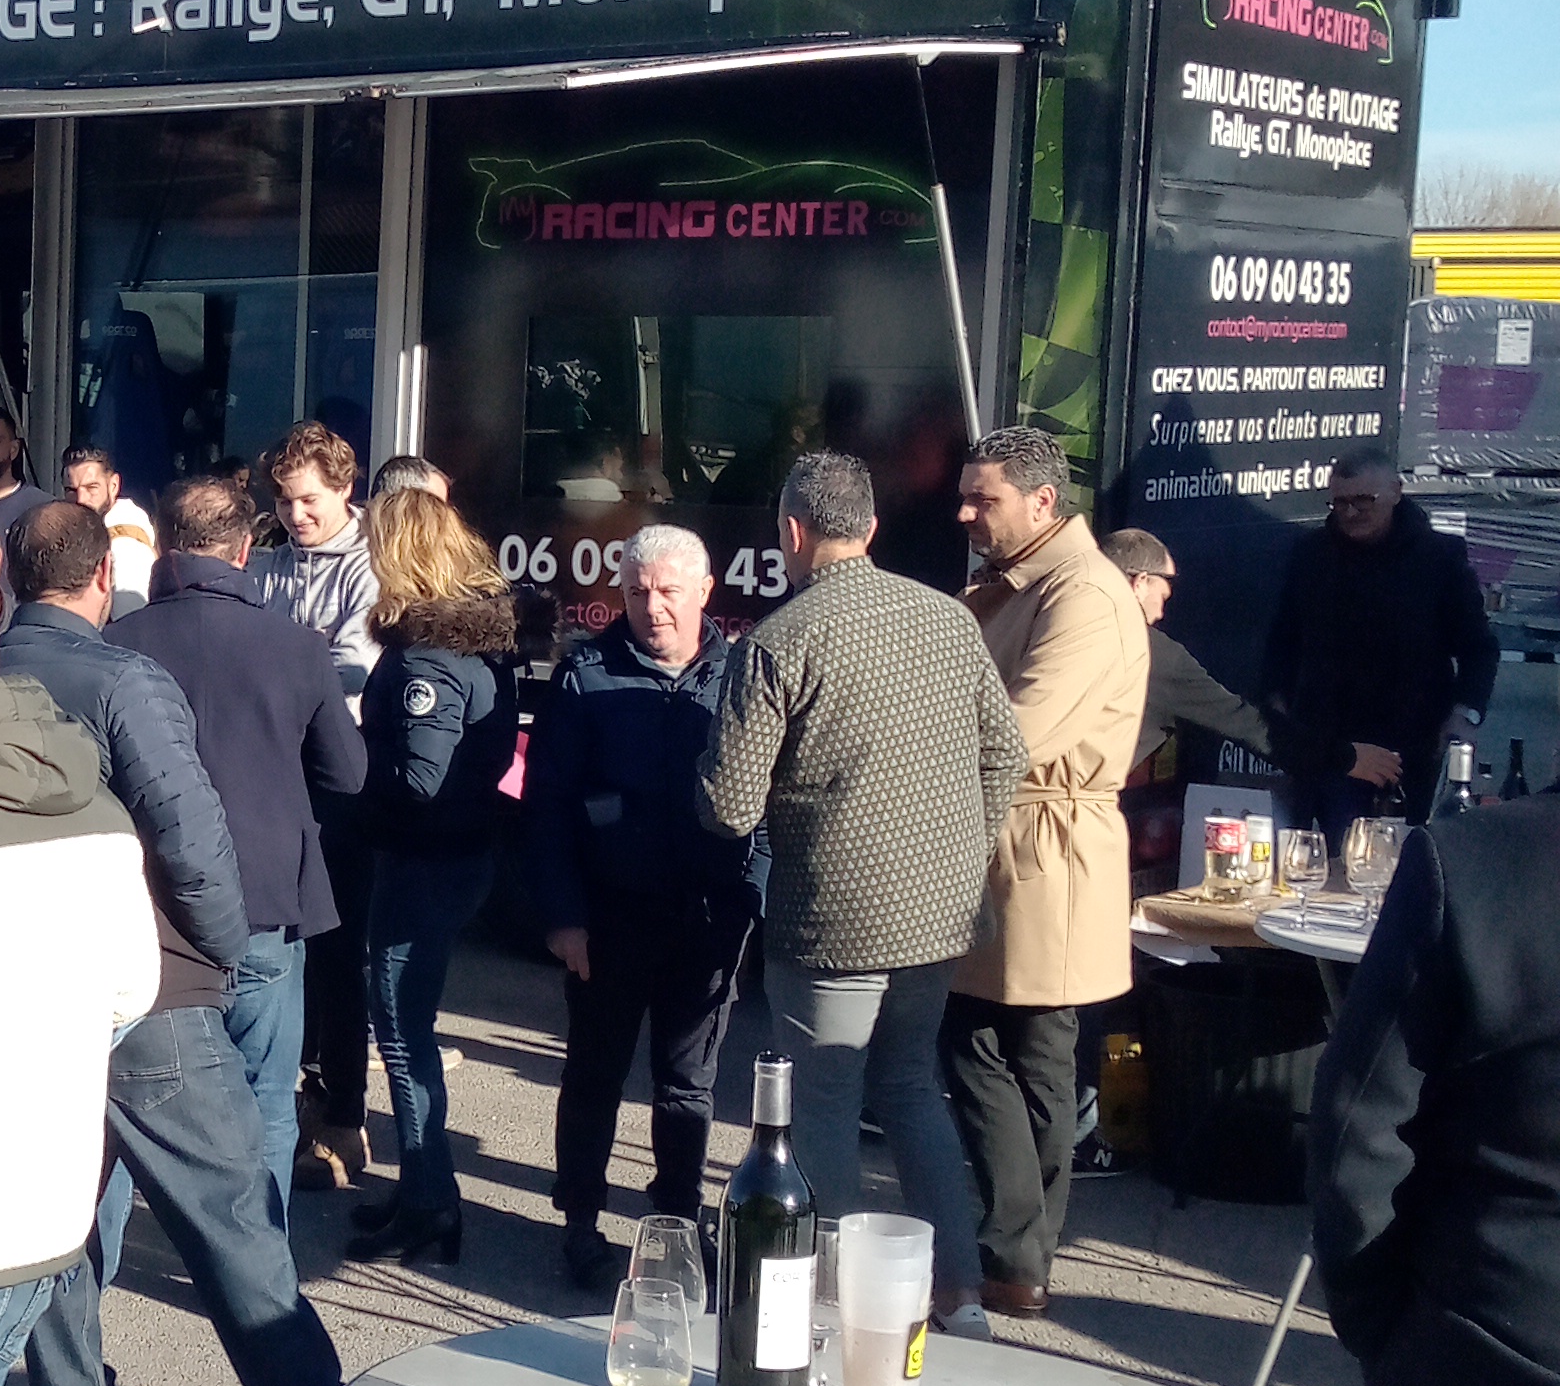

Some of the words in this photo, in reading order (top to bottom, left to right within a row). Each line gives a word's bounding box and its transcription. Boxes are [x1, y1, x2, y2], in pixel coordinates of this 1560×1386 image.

[1313, 7, 1370, 52] CENTER
[1181, 62, 1303, 116] SIMULATEURS
[1307, 85, 1325, 120] de
[1328, 88, 1401, 134] PILOTAGE
[1210, 110, 1262, 159] Rallye,
[1267, 118, 1293, 158] GT,
[1295, 123, 1373, 170] Monoplace
[543, 200, 716, 240] RACING
[726, 201, 869, 237] CENTER
[1211, 255, 1238, 301] 06
[1242, 257, 1269, 302] 09
[1270, 259, 1297, 303] 60
[1299, 261, 1324, 304] 43
[1326, 262, 1351, 305] 35
[1152, 367, 1193, 393] CHEZ
[1196, 367, 1239, 392] VOUS,
[1243, 366, 1306, 391] PARTOUT
[1308, 366, 1326, 389] EN
[1328, 366, 1378, 389] FRANCE
[1150, 413, 1234, 451] Surprenez
[1238, 420, 1264, 443] vos
[1268, 408, 1317, 441] clients
[1321, 414, 1352, 439] avec
[1356, 413, 1381, 436] une
[1145, 469, 1233, 501] animation
[1239, 463, 1290, 499] unique
[1294, 460, 1312, 488] et
[499, 534, 557, 583] 06
[725, 547, 789, 598] 43
